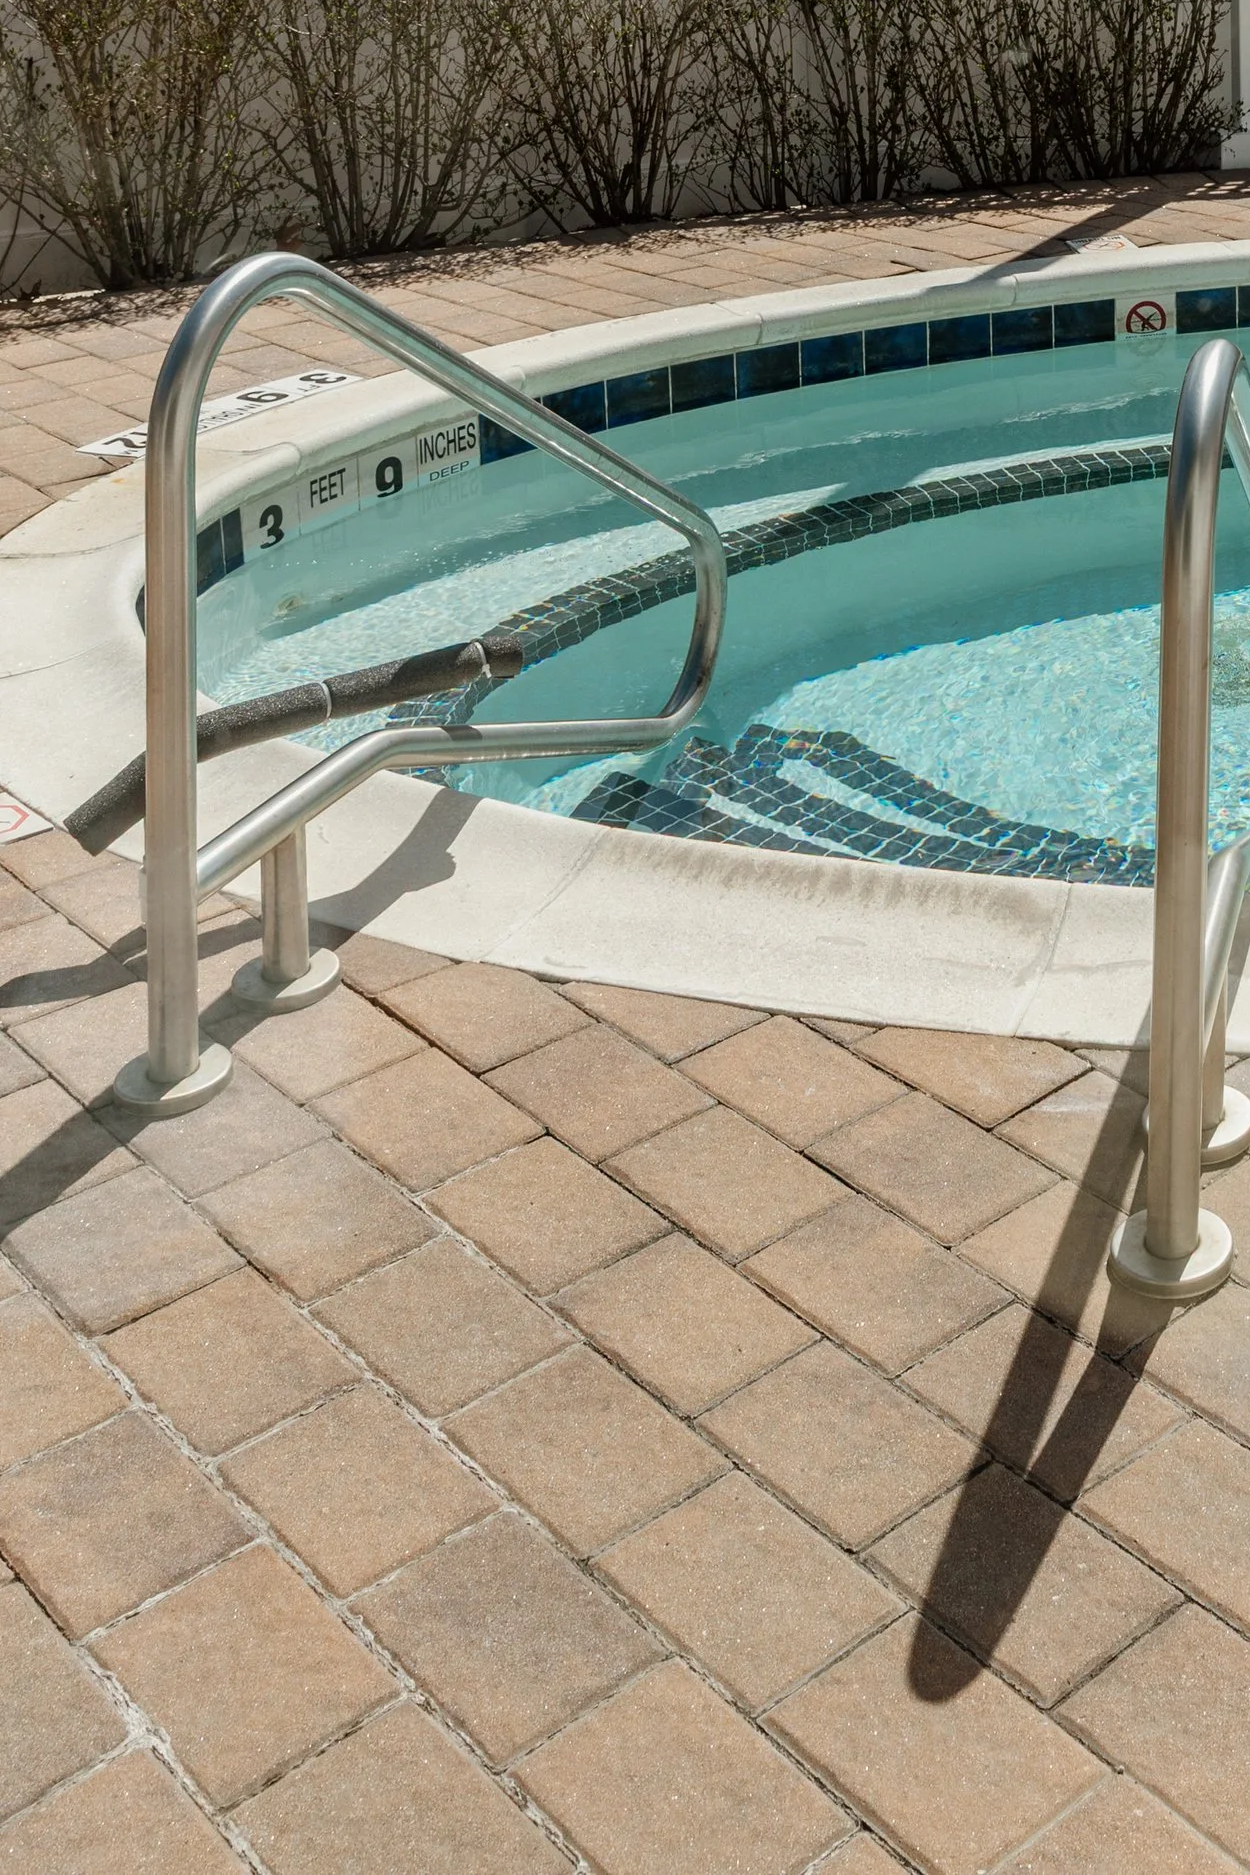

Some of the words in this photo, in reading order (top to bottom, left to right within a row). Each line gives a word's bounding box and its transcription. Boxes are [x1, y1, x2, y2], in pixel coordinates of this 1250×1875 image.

[299, 373, 347, 384] 3
[236, 391, 289, 403] 9
[429, 460, 470, 482] DEEP
[259, 504, 285, 550] 3
[310, 467, 346, 508] FEET
[375, 456, 403, 498] 9
[419, 422, 477, 465] INCHES
